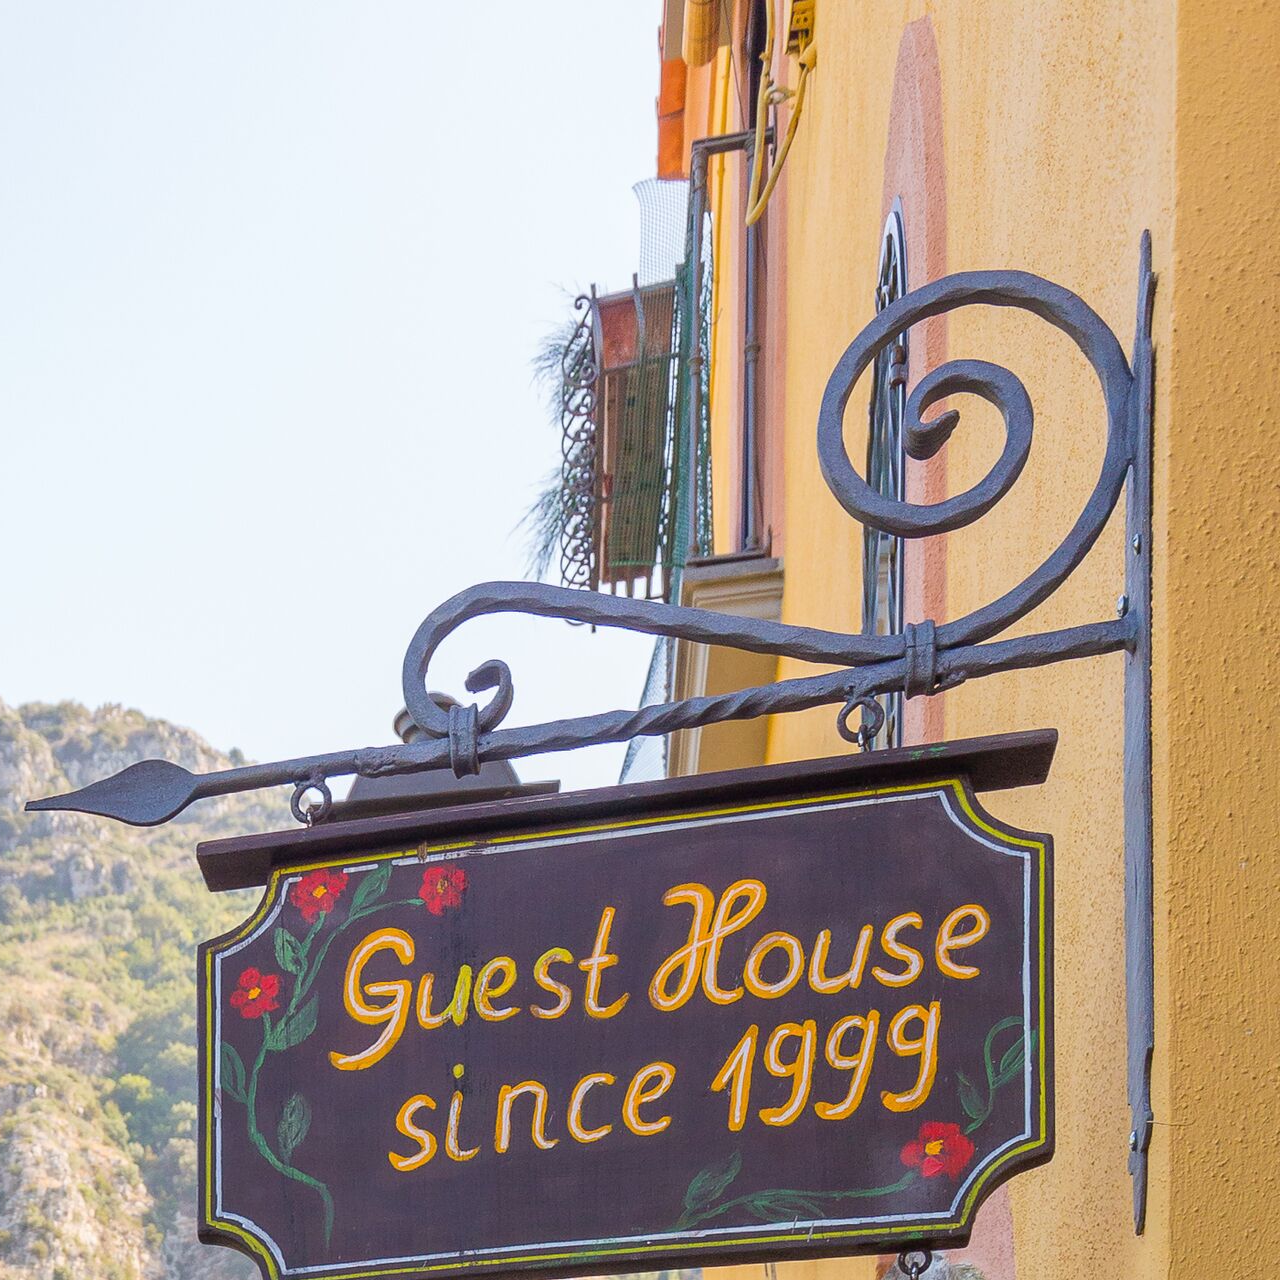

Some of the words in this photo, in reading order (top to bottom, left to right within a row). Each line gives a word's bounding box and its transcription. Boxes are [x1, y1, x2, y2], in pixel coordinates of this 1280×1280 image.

[328, 906, 630, 1071] Guest
[649, 879, 990, 1012] House
[388, 1062, 676, 1172] since
[711, 1001, 941, 1132] 1999
